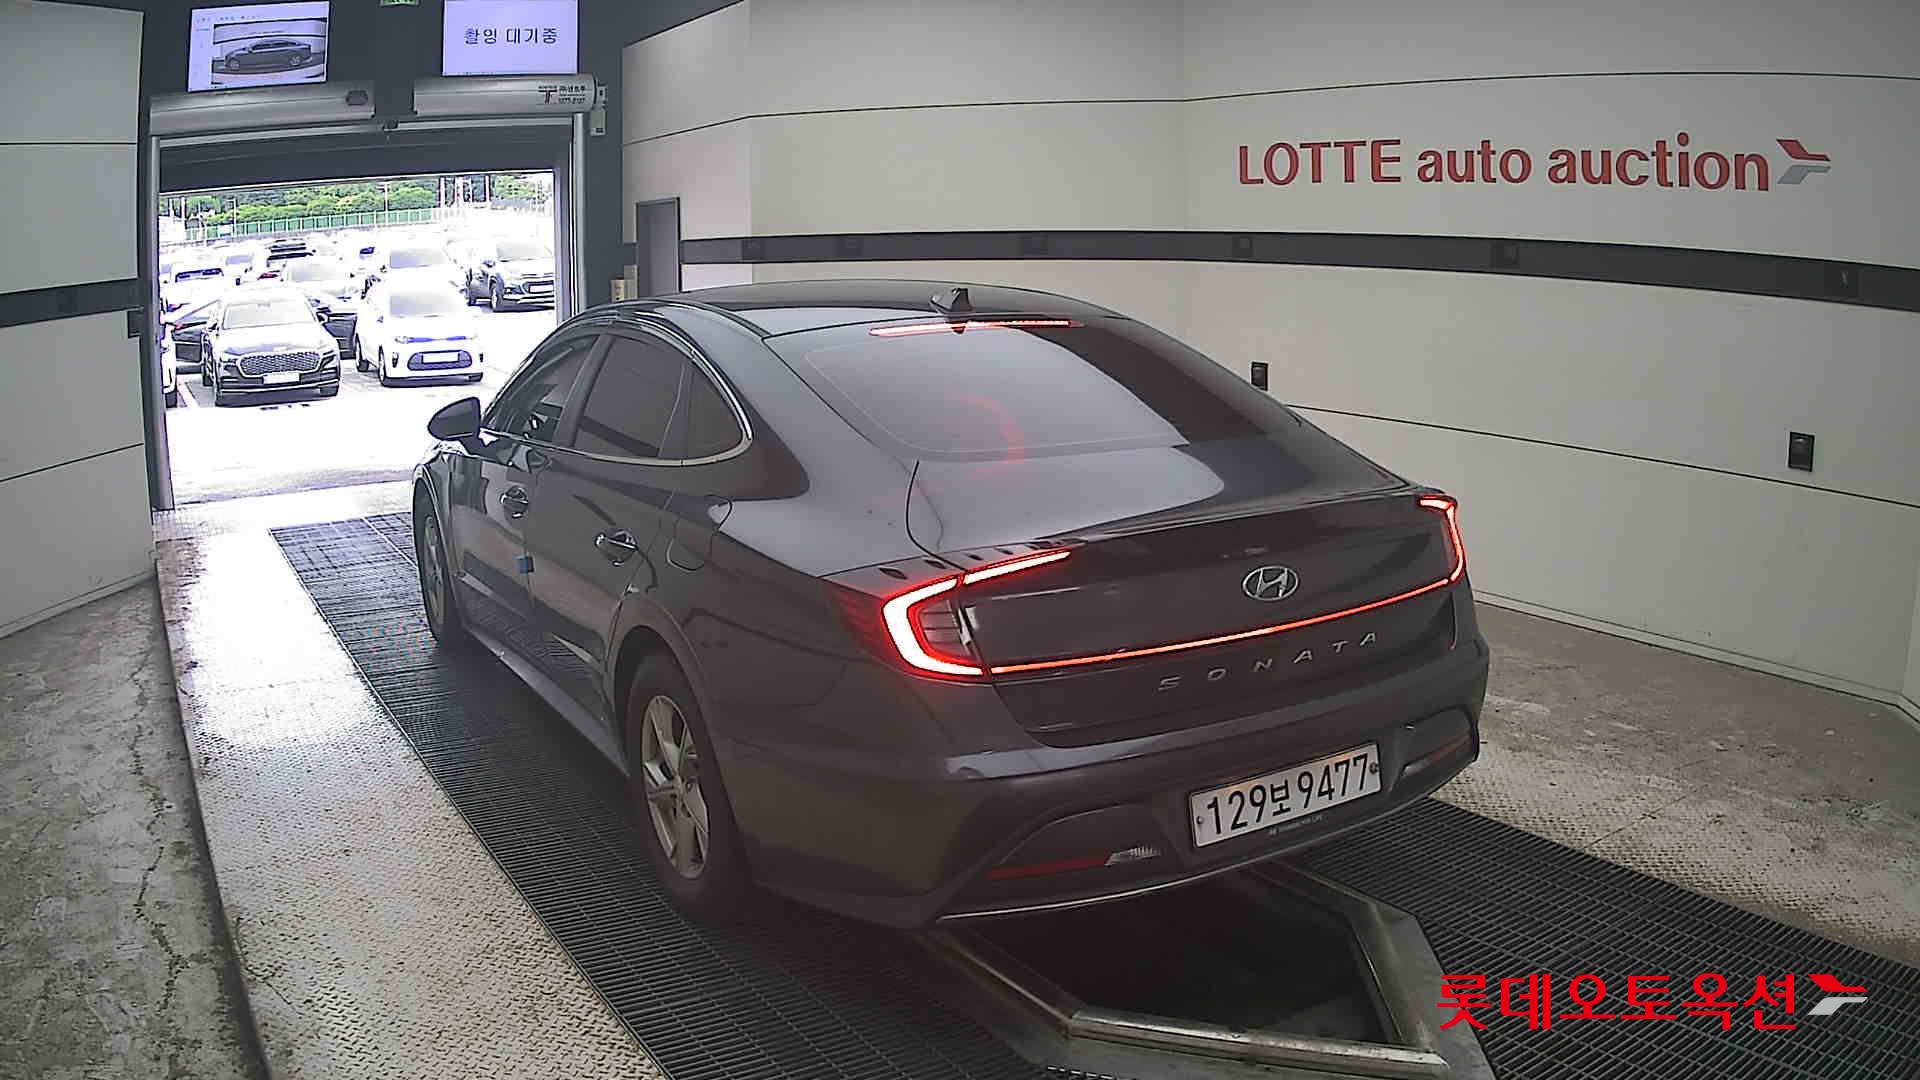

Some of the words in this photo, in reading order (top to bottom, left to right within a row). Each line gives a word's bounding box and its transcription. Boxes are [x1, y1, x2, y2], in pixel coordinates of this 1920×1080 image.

[505, 27, 558, 45] 대기중
[1239, 139, 1401, 185] LOTTE
[1417, 139, 1532, 183] auto
[1548, 132, 1770, 192] auction
[1158, 632, 1377, 691] SONATA
[1207, 753, 1369, 835] 129보9477
